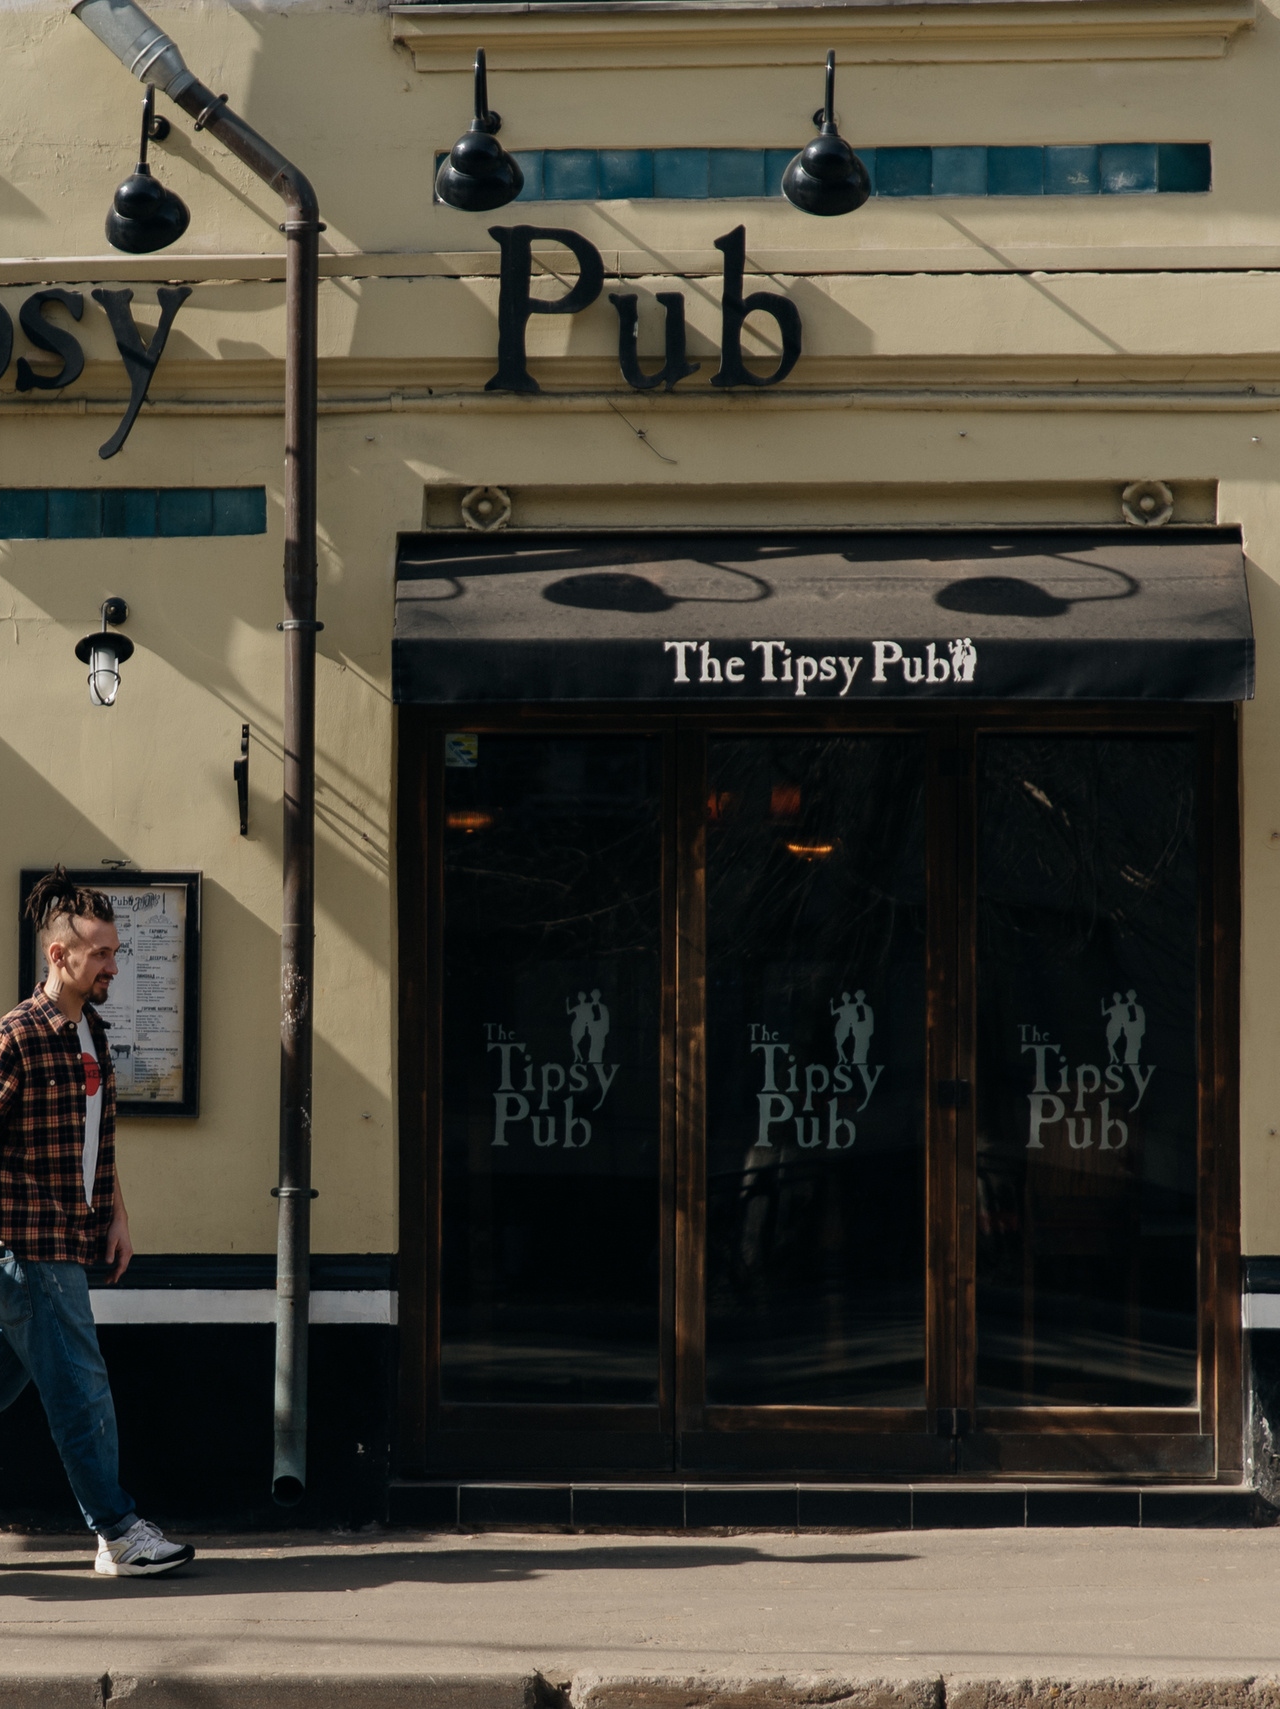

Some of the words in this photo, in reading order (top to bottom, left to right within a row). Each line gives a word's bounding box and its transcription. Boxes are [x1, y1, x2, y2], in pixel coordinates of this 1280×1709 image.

[484, 224, 802, 393] Pub
[665, 640, 745, 682] The
[752, 640, 863, 697] Tipsy
[872, 640, 952, 683] Pub
[482, 1022, 516, 1040] The
[747, 1023, 780, 1041] The
[1016, 1024, 1051, 1042] The
[486, 1042, 621, 1111] Tipsy
[750, 1043, 886, 1112] Tipsy
[1020, 1044, 1158, 1113] Tipsy
[490, 1092, 592, 1148] Pub
[754, 1093, 857, 1149] Pub
[1024, 1094, 1129, 1150] Pub
